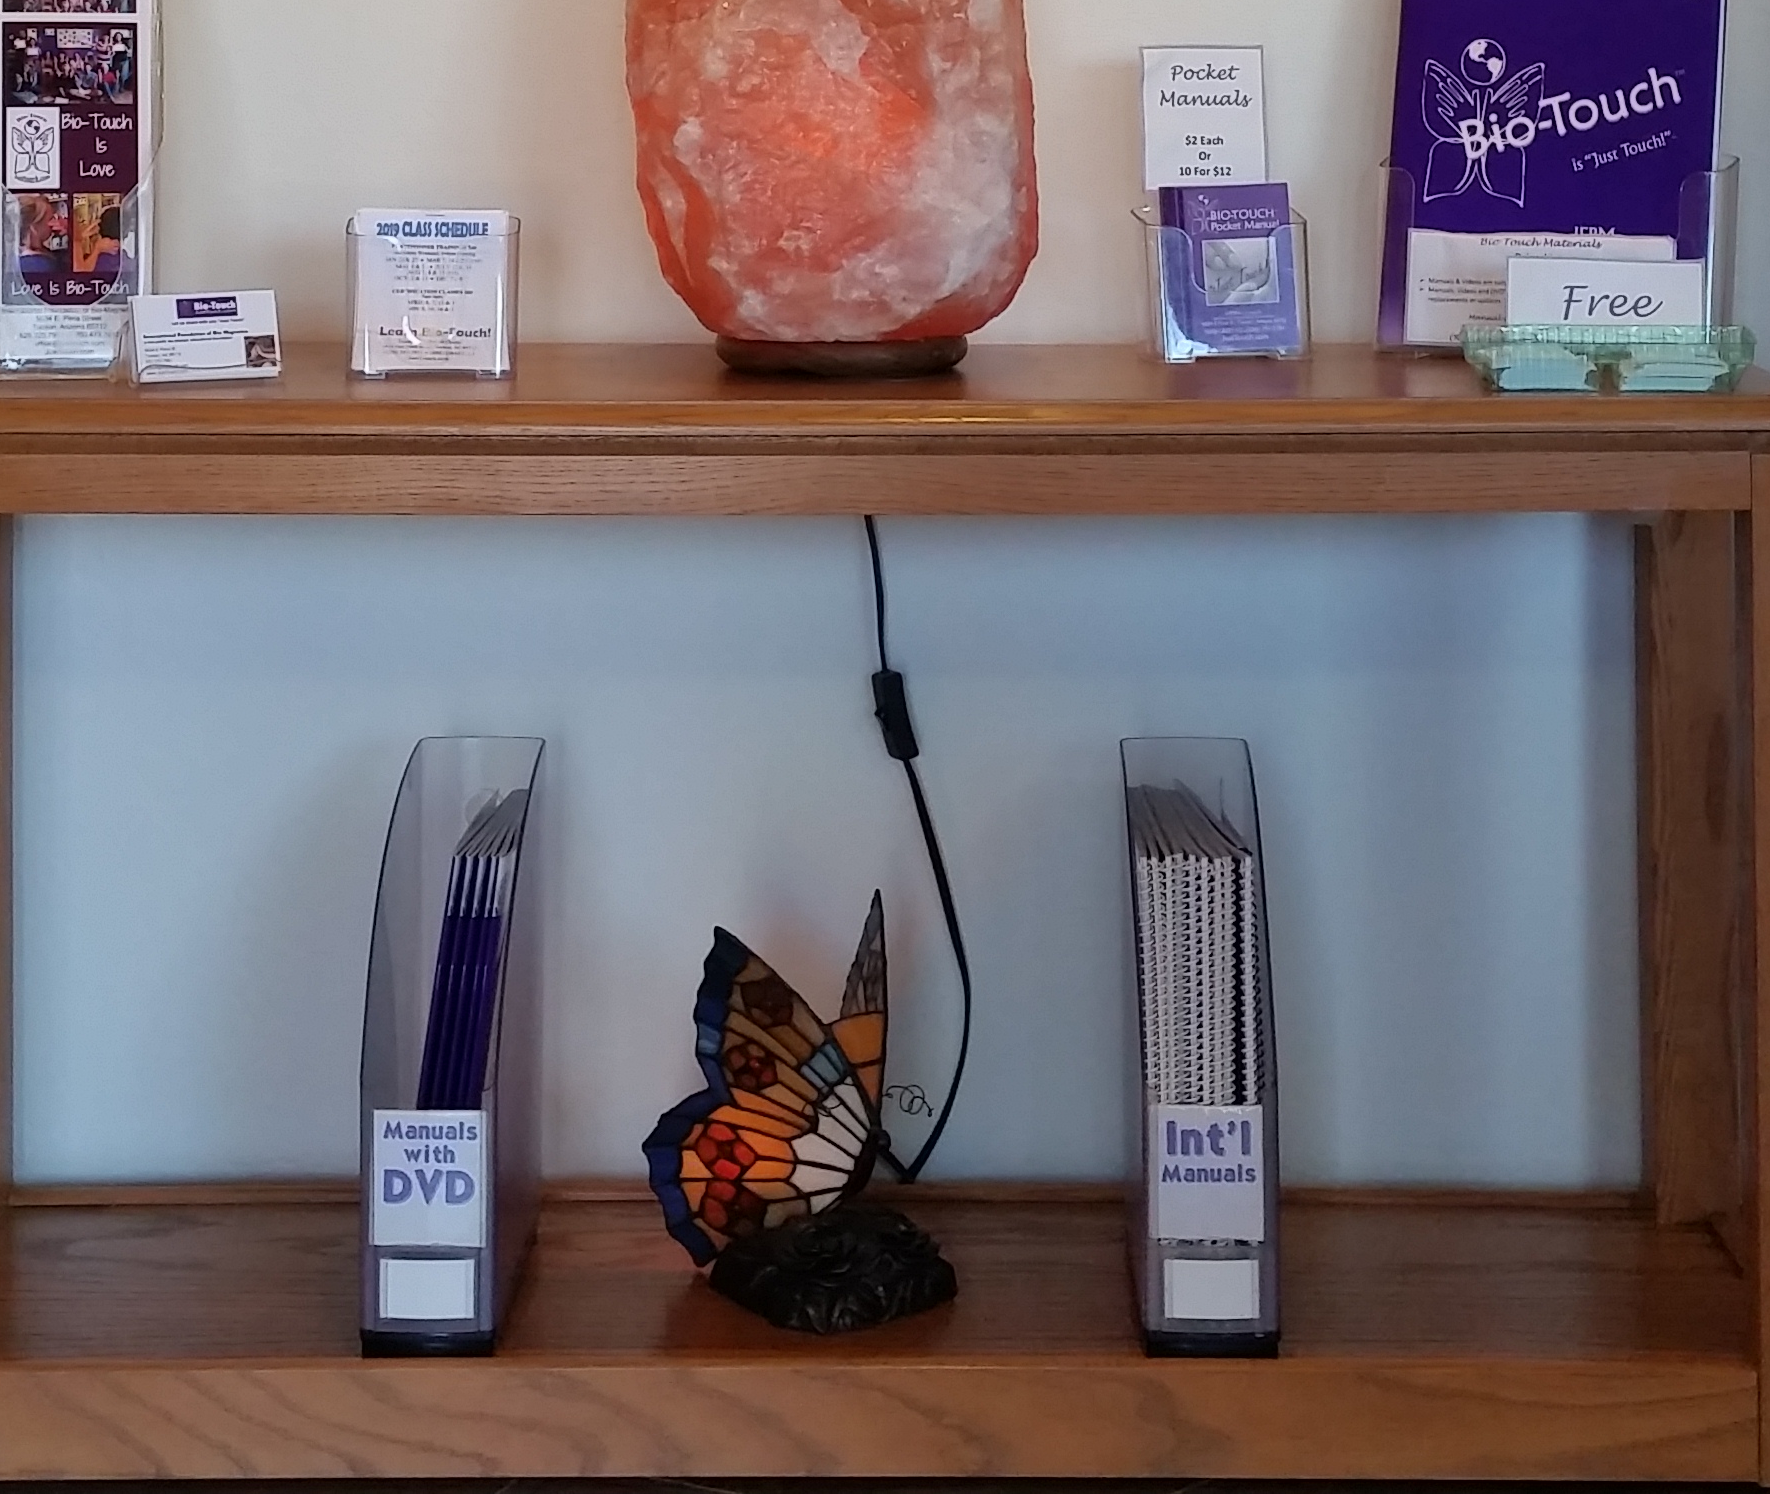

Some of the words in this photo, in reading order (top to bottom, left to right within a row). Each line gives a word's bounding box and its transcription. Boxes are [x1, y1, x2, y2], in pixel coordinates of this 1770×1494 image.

[1170, 63, 1240, 82] Pocket
[1159, 89, 1253, 108] Manuals
[61, 112, 133, 131] Bio-Touch
[95, 136, 108, 154] Is
[1185, 134, 1198, 147] $2
[1200, 135, 1224, 146] Each
[1198, 150, 1212, 161] Or
[1571, 156, 1584, 172] is
[79, 160, 116, 177] Love
[1179, 166, 1192, 177] 10
[1193, 166, 1211, 177] For
[1212, 165, 1232, 178] $12
[1209, 208, 1275, 221] BIO-TOUCH
[376, 222, 400, 238] 2019
[401, 220, 433, 238] CLASS
[434, 221, 489, 238] SCHEDULE
[1210, 221, 1241, 233] Pocket
[1244, 219, 1280, 231] Manual
[1543, 237, 1603, 249] Materials
[11, 281, 43, 296] Love
[49, 280, 61, 296] Is
[1562, 285, 1664, 321] Free
[379, 325, 418, 337] Lean
[382, 1120, 478, 1141] Manuals
[1166, 1120, 1251, 1157] Int'l
[403, 1144, 456, 1164] with
[1161, 1163, 1257, 1183] Manuals
[382, 1168, 475, 1205] DVD
